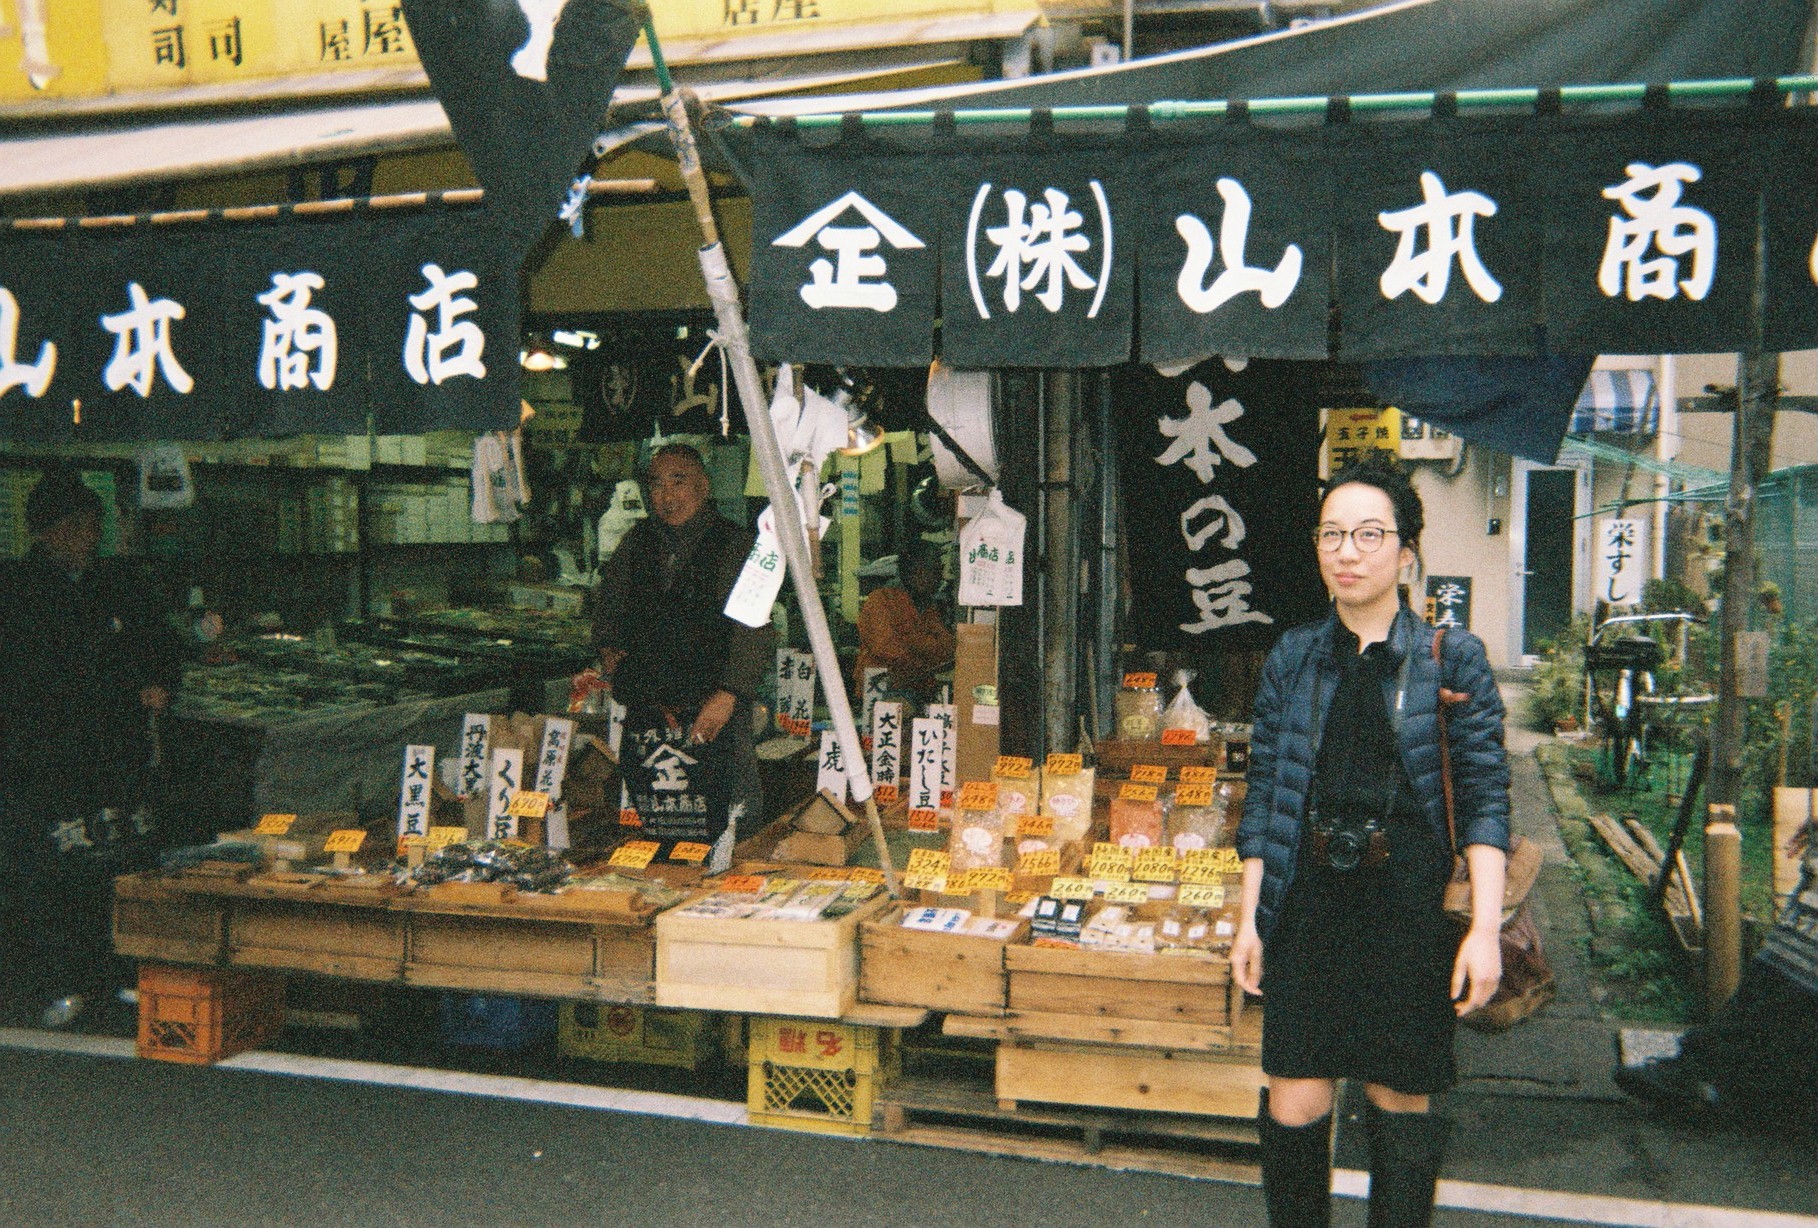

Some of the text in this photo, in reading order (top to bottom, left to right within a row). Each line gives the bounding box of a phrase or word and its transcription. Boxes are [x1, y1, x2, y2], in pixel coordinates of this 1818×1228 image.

[966, 162, 1818, 320] (株)山本商
[1154, 357, 1274, 635] 本の豆
[1606, 523, 1634, 602] 栄すし
[538, 729, 562, 793] 高原花
[876, 712, 898, 784] 大正金時
[914, 729, 939, 809] ひたし豆
[403, 757, 428, 836] 大黒豆
